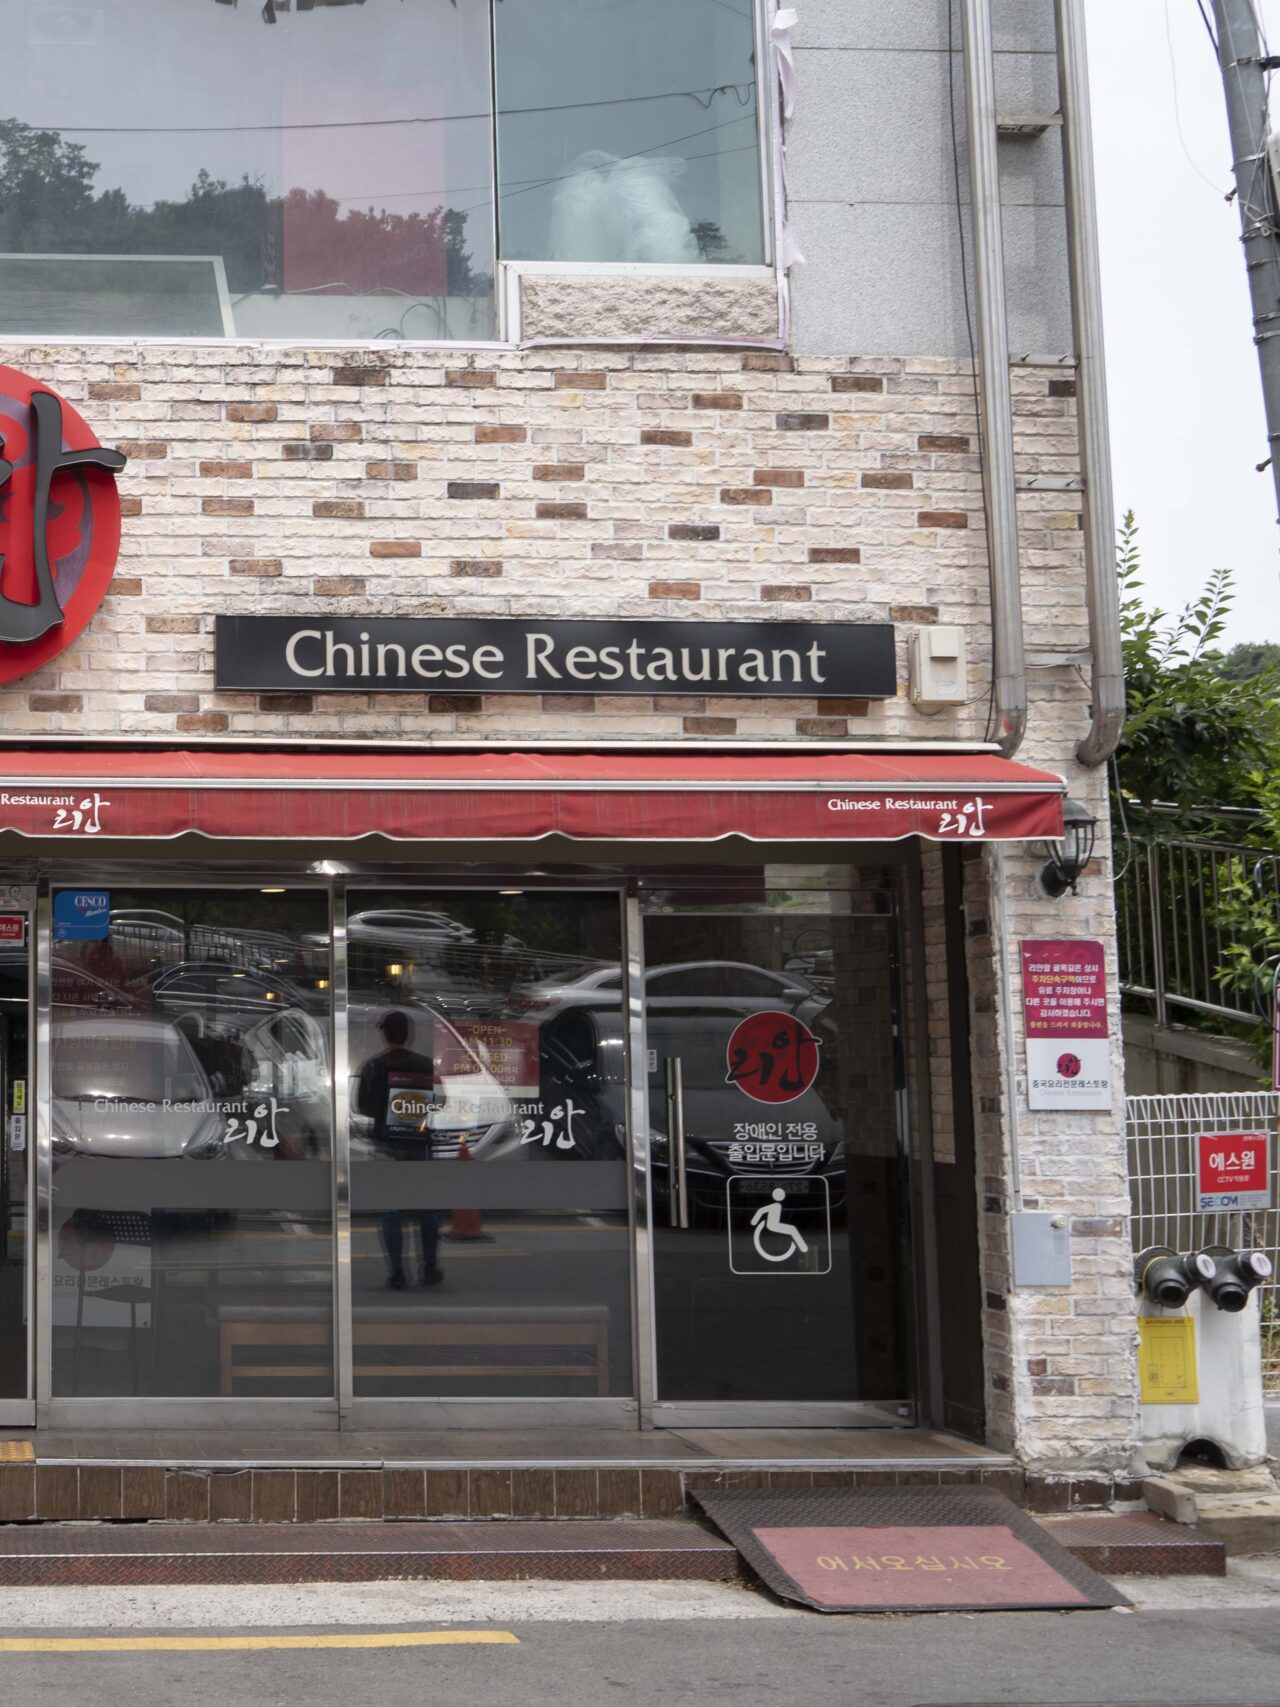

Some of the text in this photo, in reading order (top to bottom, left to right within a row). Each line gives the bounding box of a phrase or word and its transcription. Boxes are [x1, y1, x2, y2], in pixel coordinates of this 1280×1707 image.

[285, 629, 828, 683] Chinese Restaurant
[1, 793, 75, 805] Restaurant
[828, 798, 958, 810] Chinese Restaurant
[53, 793, 111, 833] 리안
[938, 797, 993, 836] 리안
[75, 895, 106, 907] CESCO
[94, 1099, 248, 1113] Chinese Restaurant
[391, 1099, 544, 1115] Chinese Restaurant
[223, 1097, 290, 1147] 리안
[521, 1099, 586, 1149] 리안
[733, 1122, 818, 1140] 장애인 전용
[728, 1143, 826, 1162] 출입문입니다
[1209, 1151, 1255, 1171] 에스원
[54, 1275, 144, 1288] 요리문레스토랑
[816, 1555, 1014, 1571] 어서오십시오
